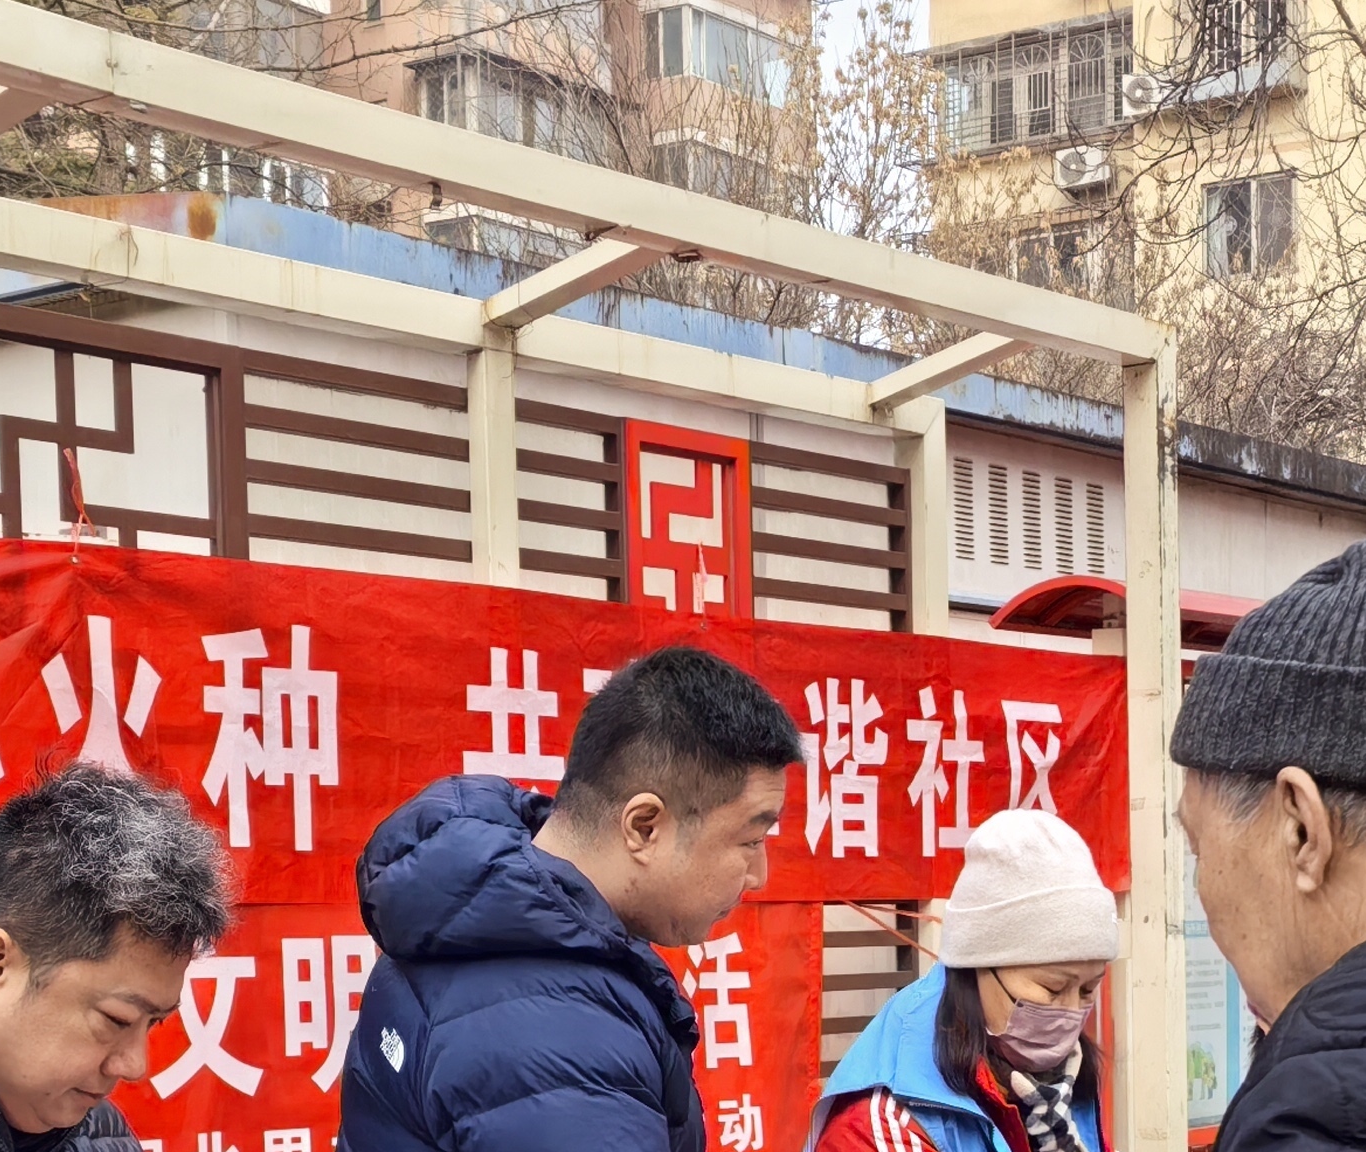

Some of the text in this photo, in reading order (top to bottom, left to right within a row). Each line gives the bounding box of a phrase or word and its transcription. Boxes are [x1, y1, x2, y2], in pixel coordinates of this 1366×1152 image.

[462, 646, 1063, 858] 共谐社区
[718, 1093, 764, 1152] 动
